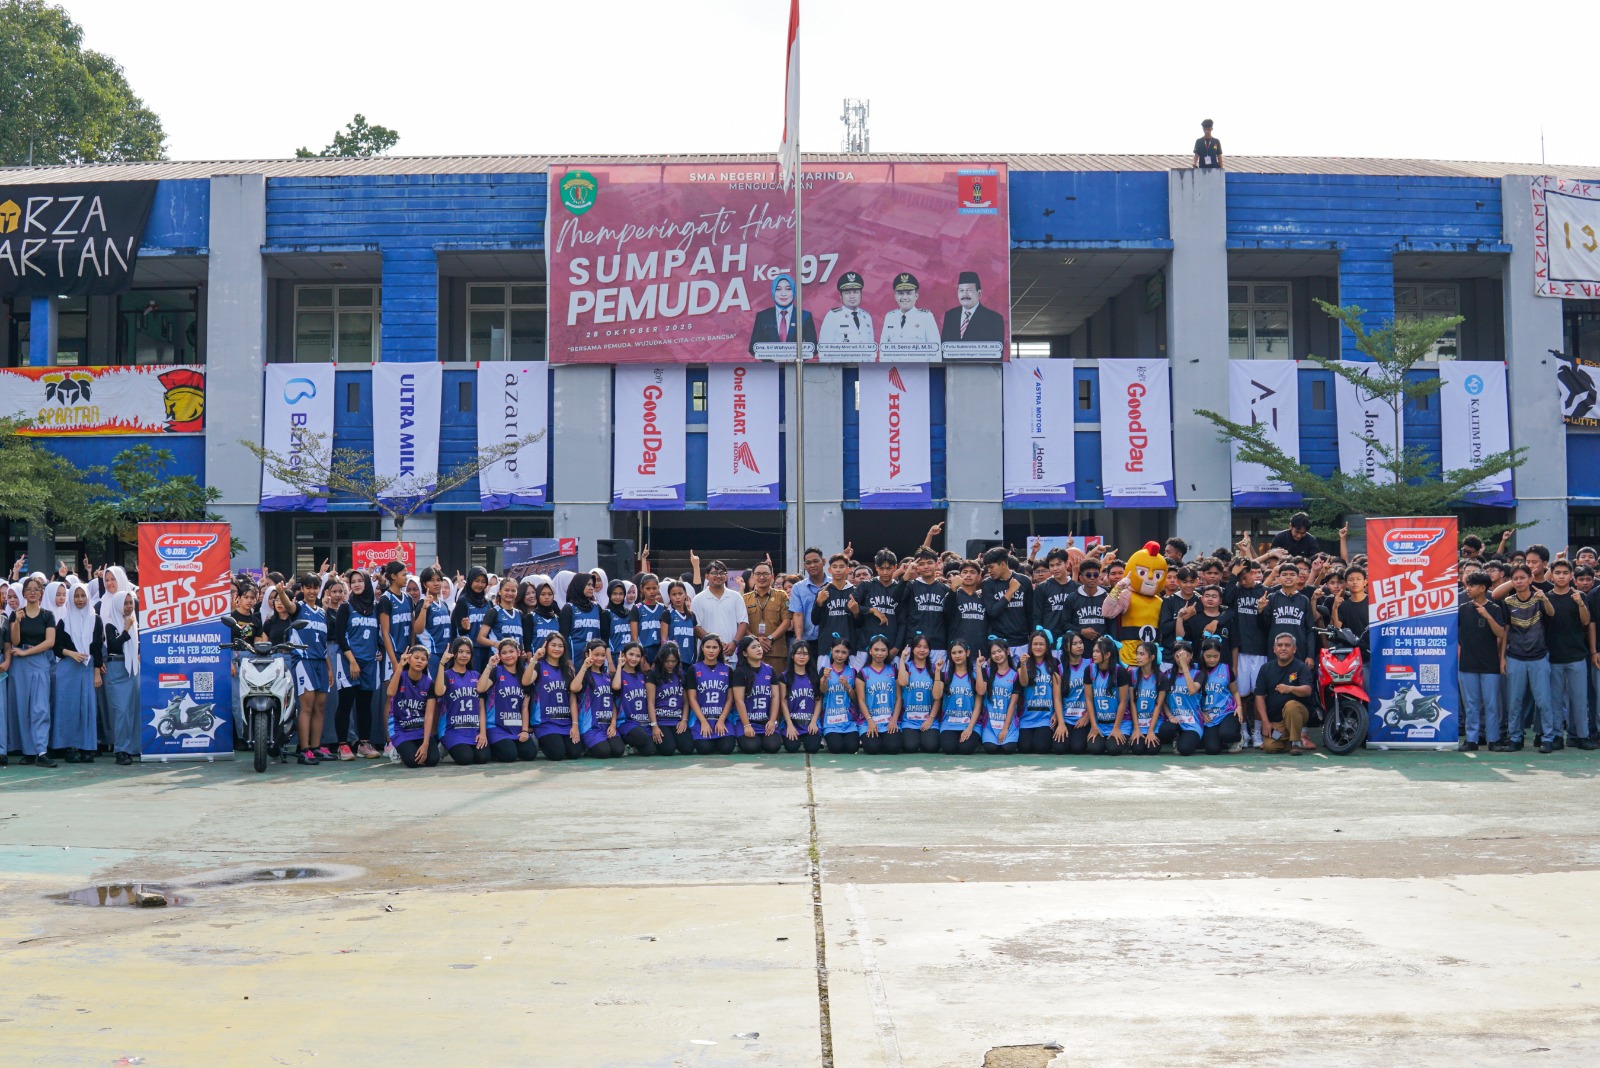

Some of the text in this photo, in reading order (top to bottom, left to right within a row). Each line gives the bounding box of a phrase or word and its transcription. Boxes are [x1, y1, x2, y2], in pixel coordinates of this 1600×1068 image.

[689, 172, 716, 181] SMA
[720, 172, 767, 181] NEGERI
[770, 172, 776, 181] 1
[729, 182, 813, 190] MENGUCAKAN
[556, 202, 796, 258] Memperingati Hari
[568, 243, 749, 286] SUMPAH
[566, 276, 752, 326] PEMUDA
[606, 326, 659, 337] OKTOBER
[665, 323, 693, 331] 2025
[634, 339, 673, 347] WUJUDKAN
[399, 373, 415, 430] ULTRA
[733, 366, 747, 436] One HEART.
[38, 406, 100, 425] SPARTAN
[1471, 398, 1481, 440] KALTIM
[888, 393, 901, 480] HONDA
[1364, 410, 1379, 479] Jackson
[399, 433, 415, 478] MILK
[1036, 447, 1045, 480] Honda
[390, 549, 409, 561] Dy
[1372, 569, 1424, 600] LET'S
[143, 576, 196, 607] LET'S
[993, 589, 1025, 600] SMSA
[827, 598, 848, 610] SMAN
[914, 593, 944, 606] SMANSA
[1237, 596, 1259, 607] SMANS
[1377, 588, 1455, 621] GET LOUD
[147, 594, 228, 629] GET LOUD
[1273, 605, 1305, 619] SMANSA
[651, 630, 658, 640] 4
[1381, 626, 1447, 636] EAST KALIMANTAN
[152, 633, 221, 644] EAST KALIMANTAN
[1395, 638, 1447, 647] 6-14 FEB 2026
[167, 645, 221, 655] 6-14 FEB 2026
[1382, 648, 1393, 656] GOR
[1414, 648, 1446, 656] SAMARINDA
[154, 656, 167, 664] GOR
[187, 655, 220, 664] SAMARINDA
[498, 686, 525, 698] SMANS
[543, 680, 567, 693] SMAN
[593, 685, 613, 698] SMAN
[697, 679, 729, 693] SMANSA
[1034, 685, 1047, 696] 13
[556, 692, 564, 703] 8
[624, 688, 647, 702] SMANS
[658, 686, 684, 699] SMANS
[705, 691, 720, 704] 12
[915, 691, 924, 702] 9
[1075, 689, 1083, 699] 7
[510, 697, 519, 709] 7
[603, 696, 611, 708] 5
[635, 699, 643, 711] 9
[668, 697, 677, 708] 6
[752, 697, 767, 710] 15
[798, 698, 806, 710] 4
[835, 694, 844, 705] 5
[875, 693, 888, 705] 10
[955, 697, 963, 708] 4
[992, 698, 1004, 710] 14
[1096, 699, 1109, 710] 15
[1140, 700, 1148, 710] 6
[1175, 696, 1183, 706] 8
[459, 699, 473, 712] 14
